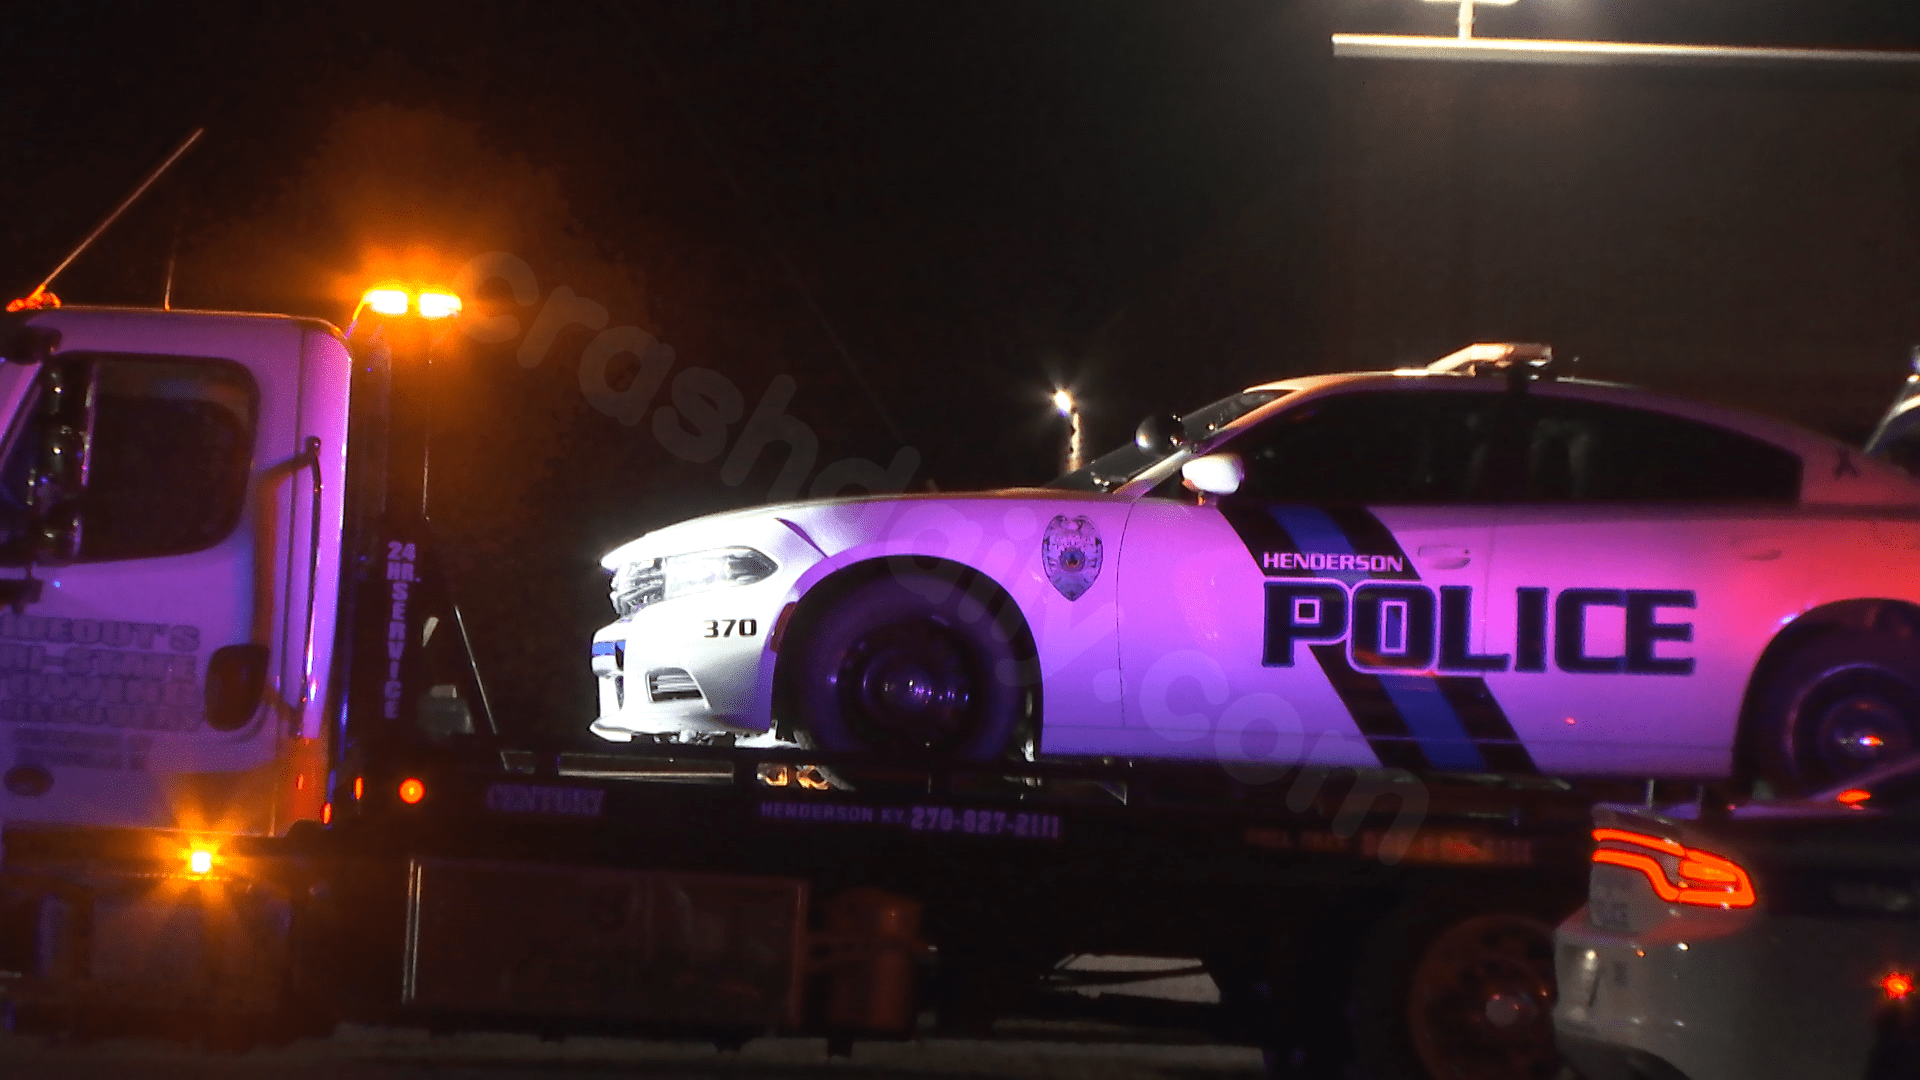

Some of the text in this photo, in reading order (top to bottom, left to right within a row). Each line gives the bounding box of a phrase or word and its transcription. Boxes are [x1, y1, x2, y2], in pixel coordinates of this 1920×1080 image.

[387, 541, 417, 562] 24
[1263, 552, 1404, 573] HENDERSON
[704, 618, 758, 638] 370
[1262, 581, 1696, 675] POLICE
[383, 583, 409, 720] SERVICE
[760, 801, 874, 823] HENDERSON
